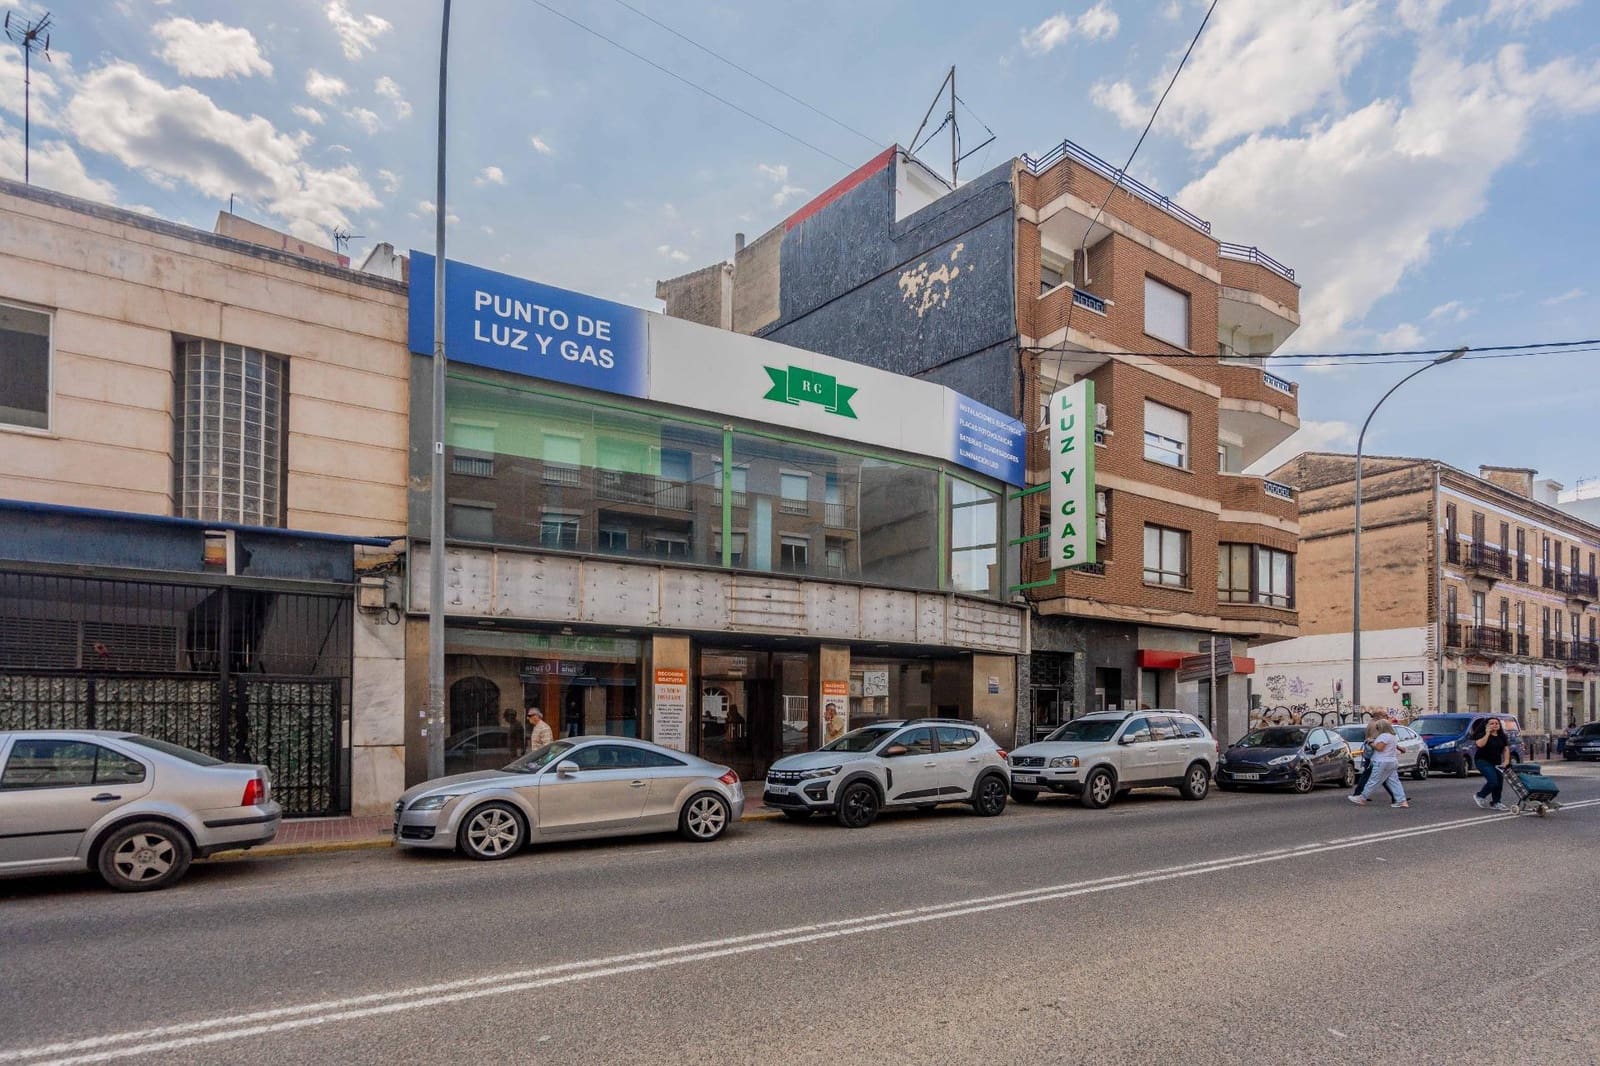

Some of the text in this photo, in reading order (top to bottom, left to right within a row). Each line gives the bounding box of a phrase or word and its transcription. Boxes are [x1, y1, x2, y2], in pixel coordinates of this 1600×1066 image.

[474, 290, 611, 341] PUNTO DE
[474, 319, 615, 369] LUZ Y GAS
[1060, 395, 1076, 560] LUZ Y GAS
